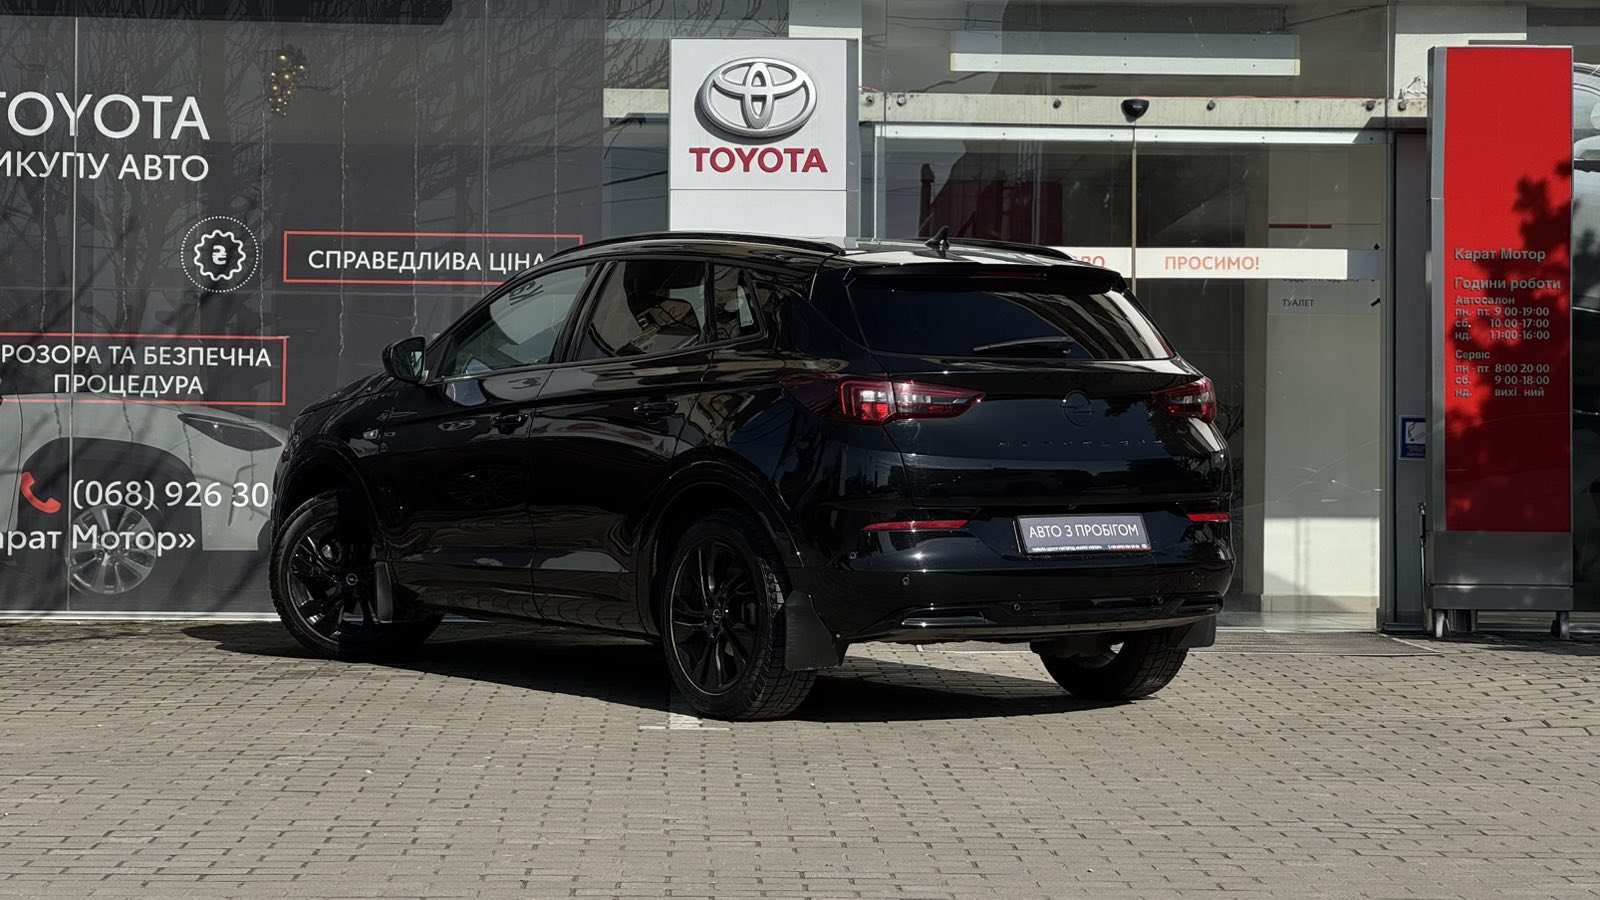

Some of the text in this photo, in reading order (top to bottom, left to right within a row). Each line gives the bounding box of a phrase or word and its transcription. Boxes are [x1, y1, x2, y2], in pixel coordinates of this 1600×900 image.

[0, 91, 210, 140] OYOTA
[118, 154, 209, 181] АВТО
[689, 147, 828, 173] TOYOTA
[308, 250, 482, 273] СПРАВЕДЛИВА
[1165, 256, 1260, 271] ПРОСИМО!
[1455, 248, 1546, 262] Карат Мотор
[1455, 277, 1561, 291] Години роботи
[1282, 298, 1315, 307] ТУАЛЕТ
[1455, 295, 1515, 305] Автосалон
[1455, 318, 1472, 329] сб.
[1489, 330, 1550, 340] 11:00-16:00
[1, 345, 271, 367] РОЗОРА ТА БЕЗПЕЧНА
[54, 374, 204, 397] ПРОЦЕДУРА
[73, 480, 269, 510] (068) 926 30
[72, 524, 196, 557] Мотор»
[1029, 525, 1062, 539] АВТО
[1075, 523, 1139, 537] ПРОБІГОМ
